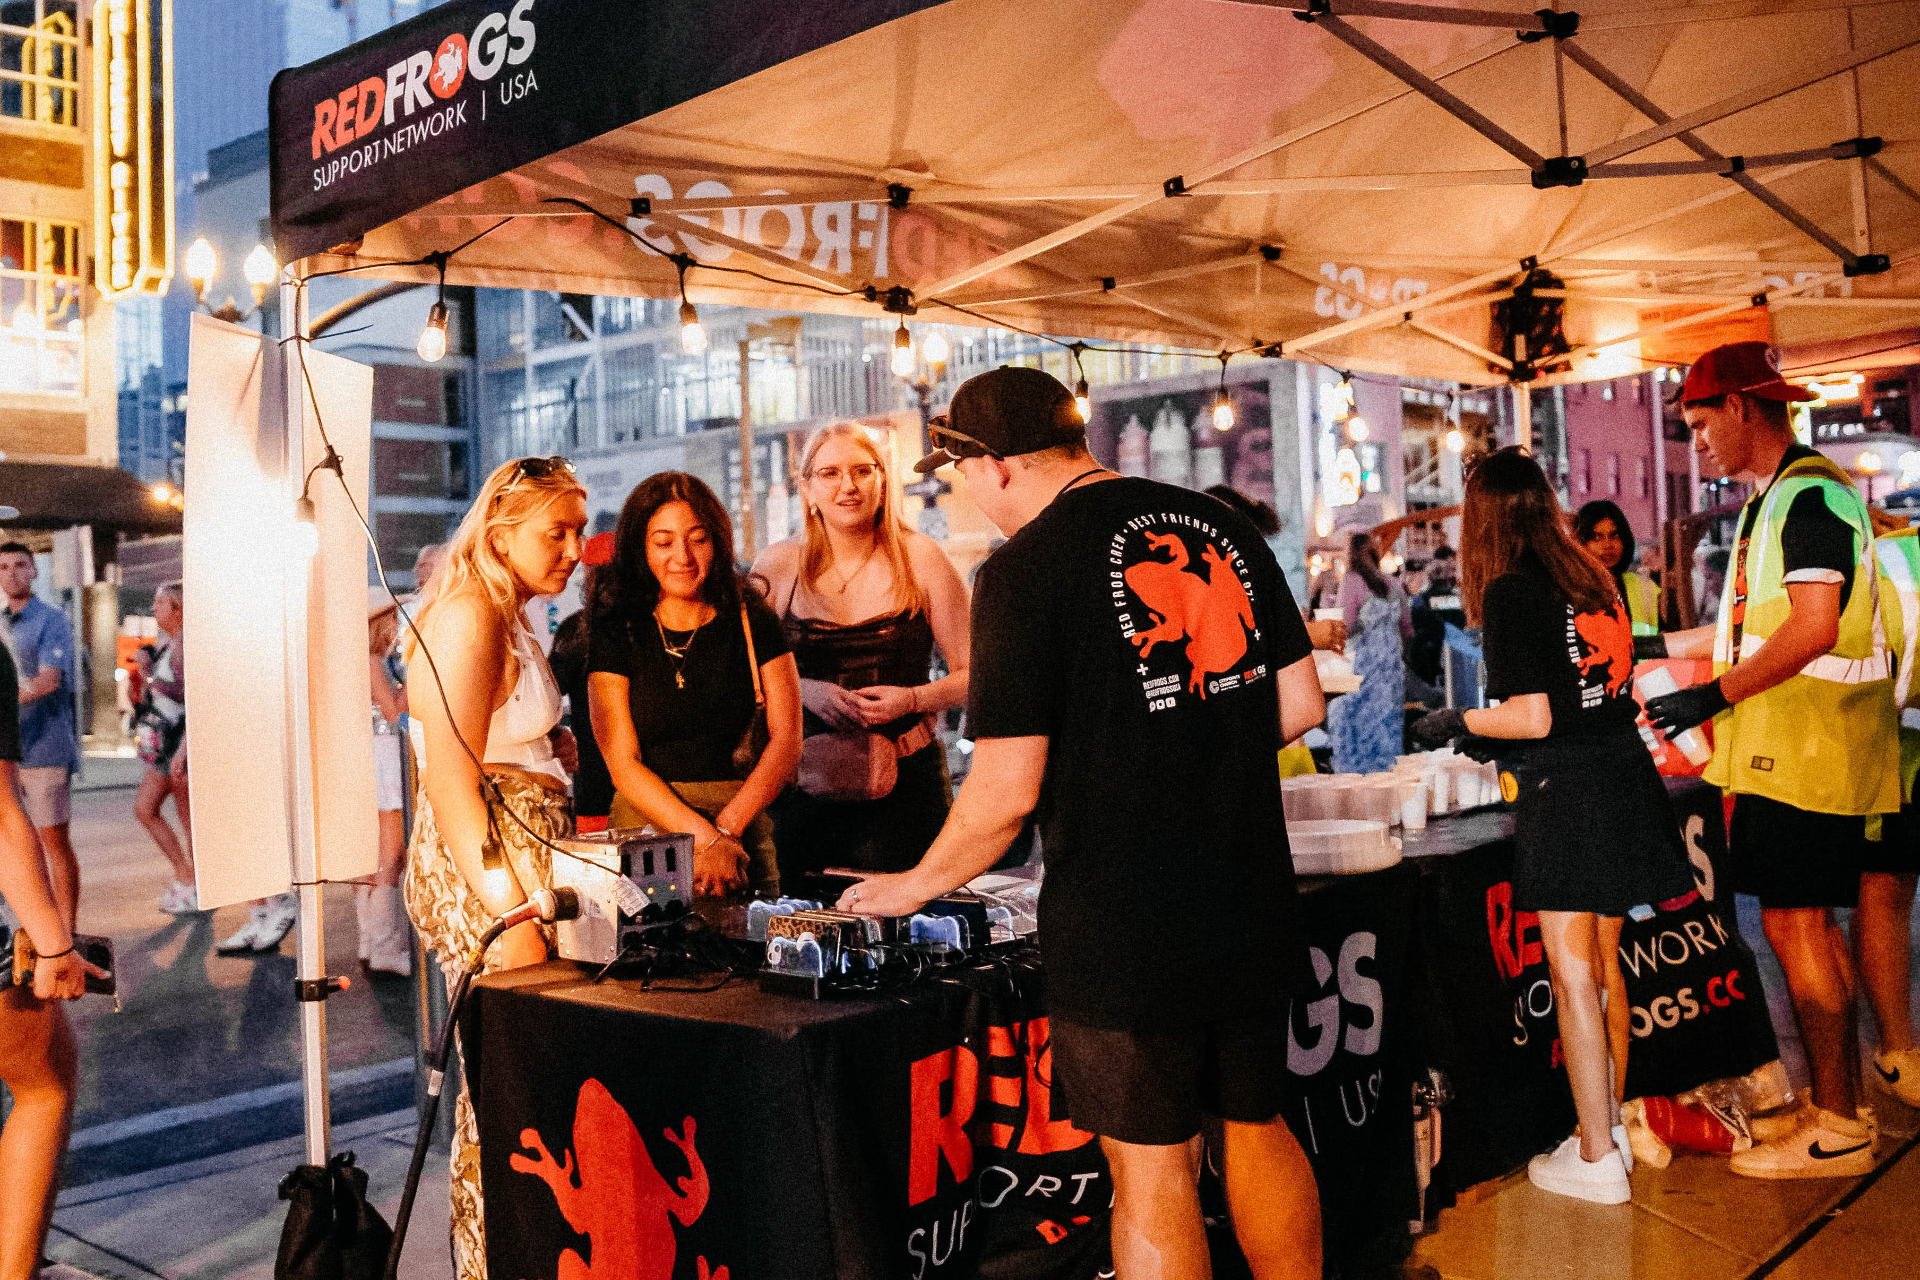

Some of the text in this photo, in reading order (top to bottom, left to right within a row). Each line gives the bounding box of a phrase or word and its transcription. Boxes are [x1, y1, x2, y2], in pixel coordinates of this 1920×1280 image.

[311, 0, 537, 161] REDFROGS
[313, 69, 539, 192] SUPPORT NETWORK USA
[1127, 513, 1157, 531] BEST
[1161, 513, 1218, 538] FRIENDS
[1110, 533, 1127, 565] CREW
[1221, 538, 1249, 576] SINCE
[1110, 571, 1127, 608] FROG
[1118, 613, 1136, 639] RED
[1619, 913, 1729, 978] WORK
[1629, 970, 1745, 1038] OGS.CC
